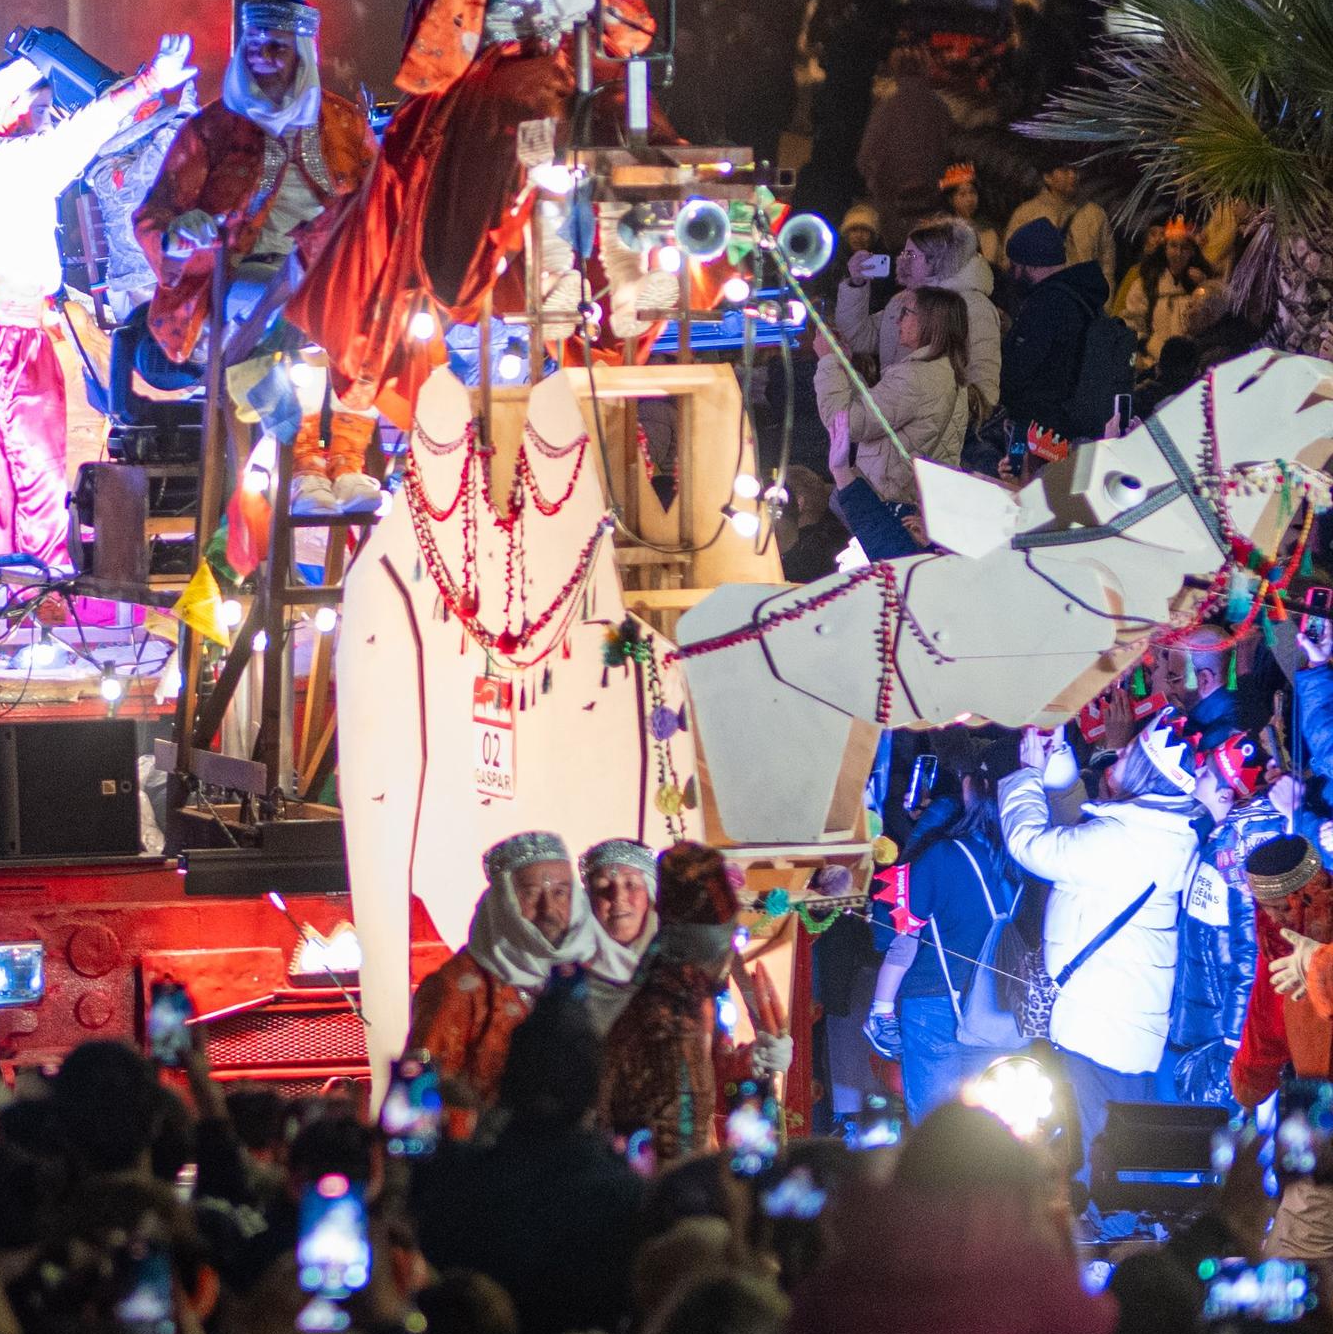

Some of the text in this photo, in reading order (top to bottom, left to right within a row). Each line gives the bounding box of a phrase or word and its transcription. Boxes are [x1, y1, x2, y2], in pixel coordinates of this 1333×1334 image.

[482, 731, 501, 768] 02
[1196, 874, 1213, 891] PEPE
[1191, 896, 1207, 910] LDN
[1193, 886, 1220, 905] JEANS
